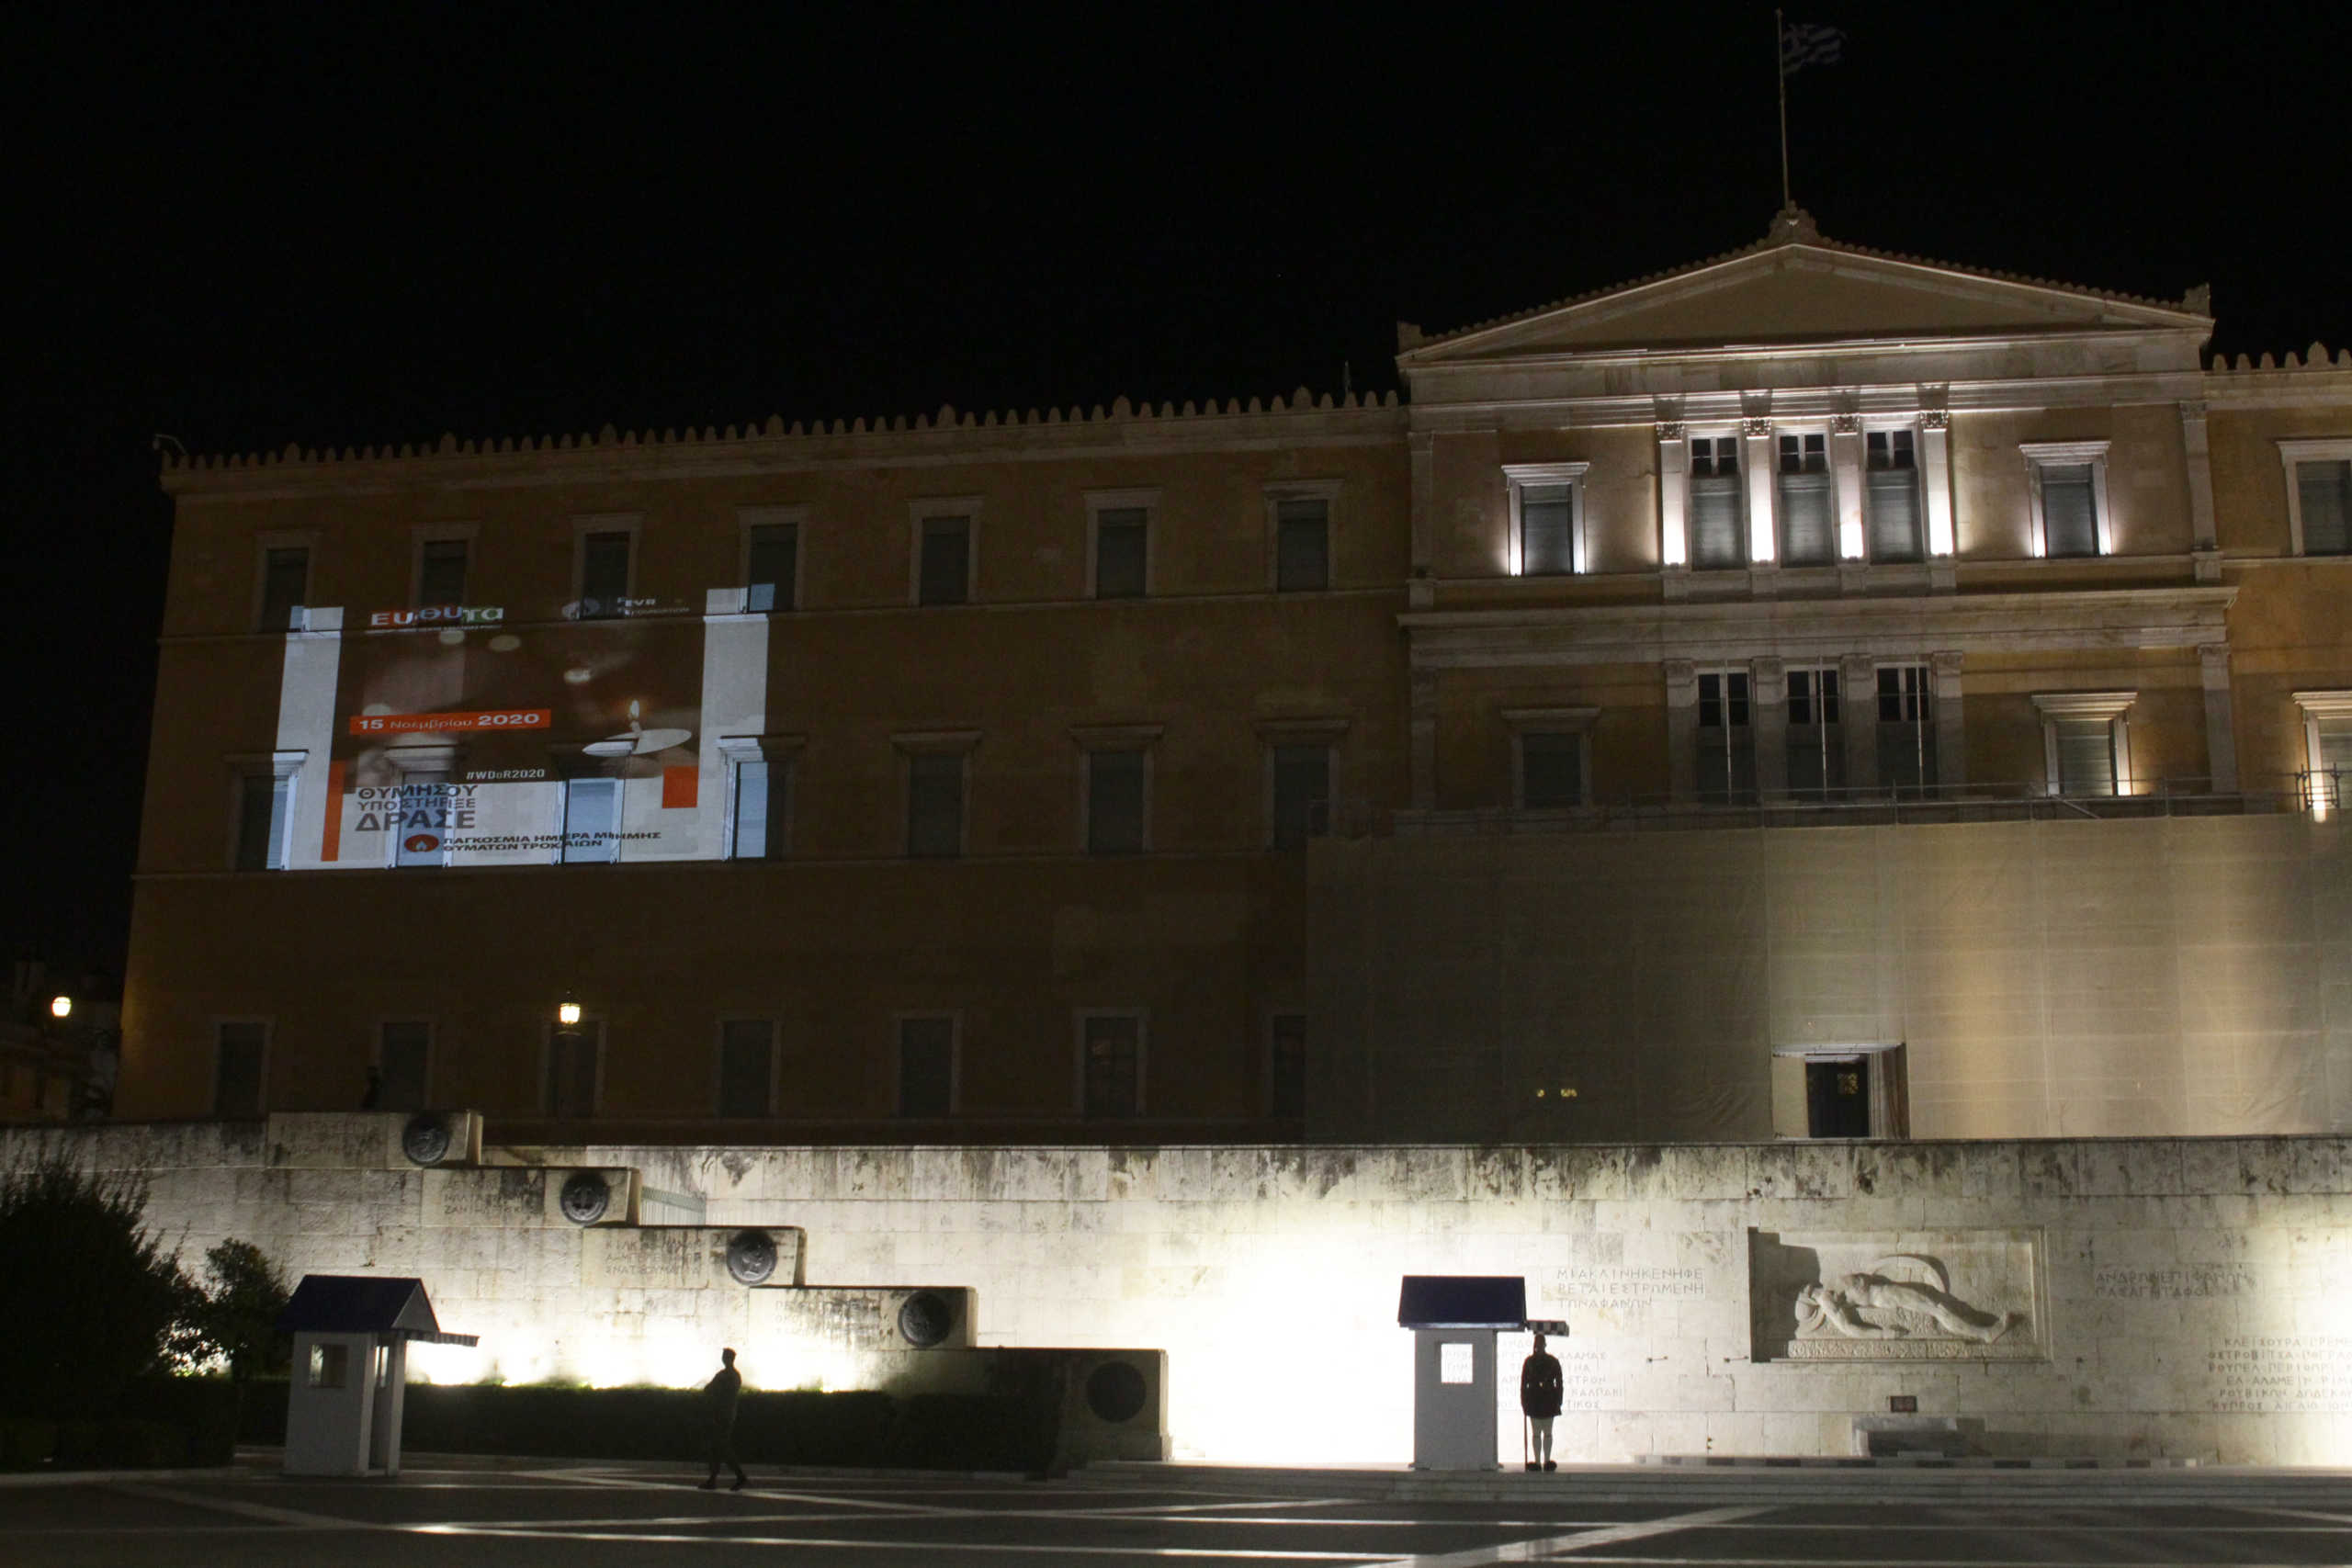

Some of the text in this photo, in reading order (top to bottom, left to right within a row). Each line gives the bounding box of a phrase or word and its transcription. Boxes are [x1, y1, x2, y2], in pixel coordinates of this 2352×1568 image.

[359, 719, 383, 730] 15
[478, 713, 540, 727] 2020
[358, 784, 479, 799] ΘΥΜΗΣΟΥ
[355, 809, 477, 832] ΔΡΑΣΕ
[443, 834, 530, 844] ΠΑΓΚΟΣΜΙΑ
[534, 832, 591, 842] ΗΜΕΡΑ
[443, 841, 518, 852] ΘΥΜΑΤΩΝ
